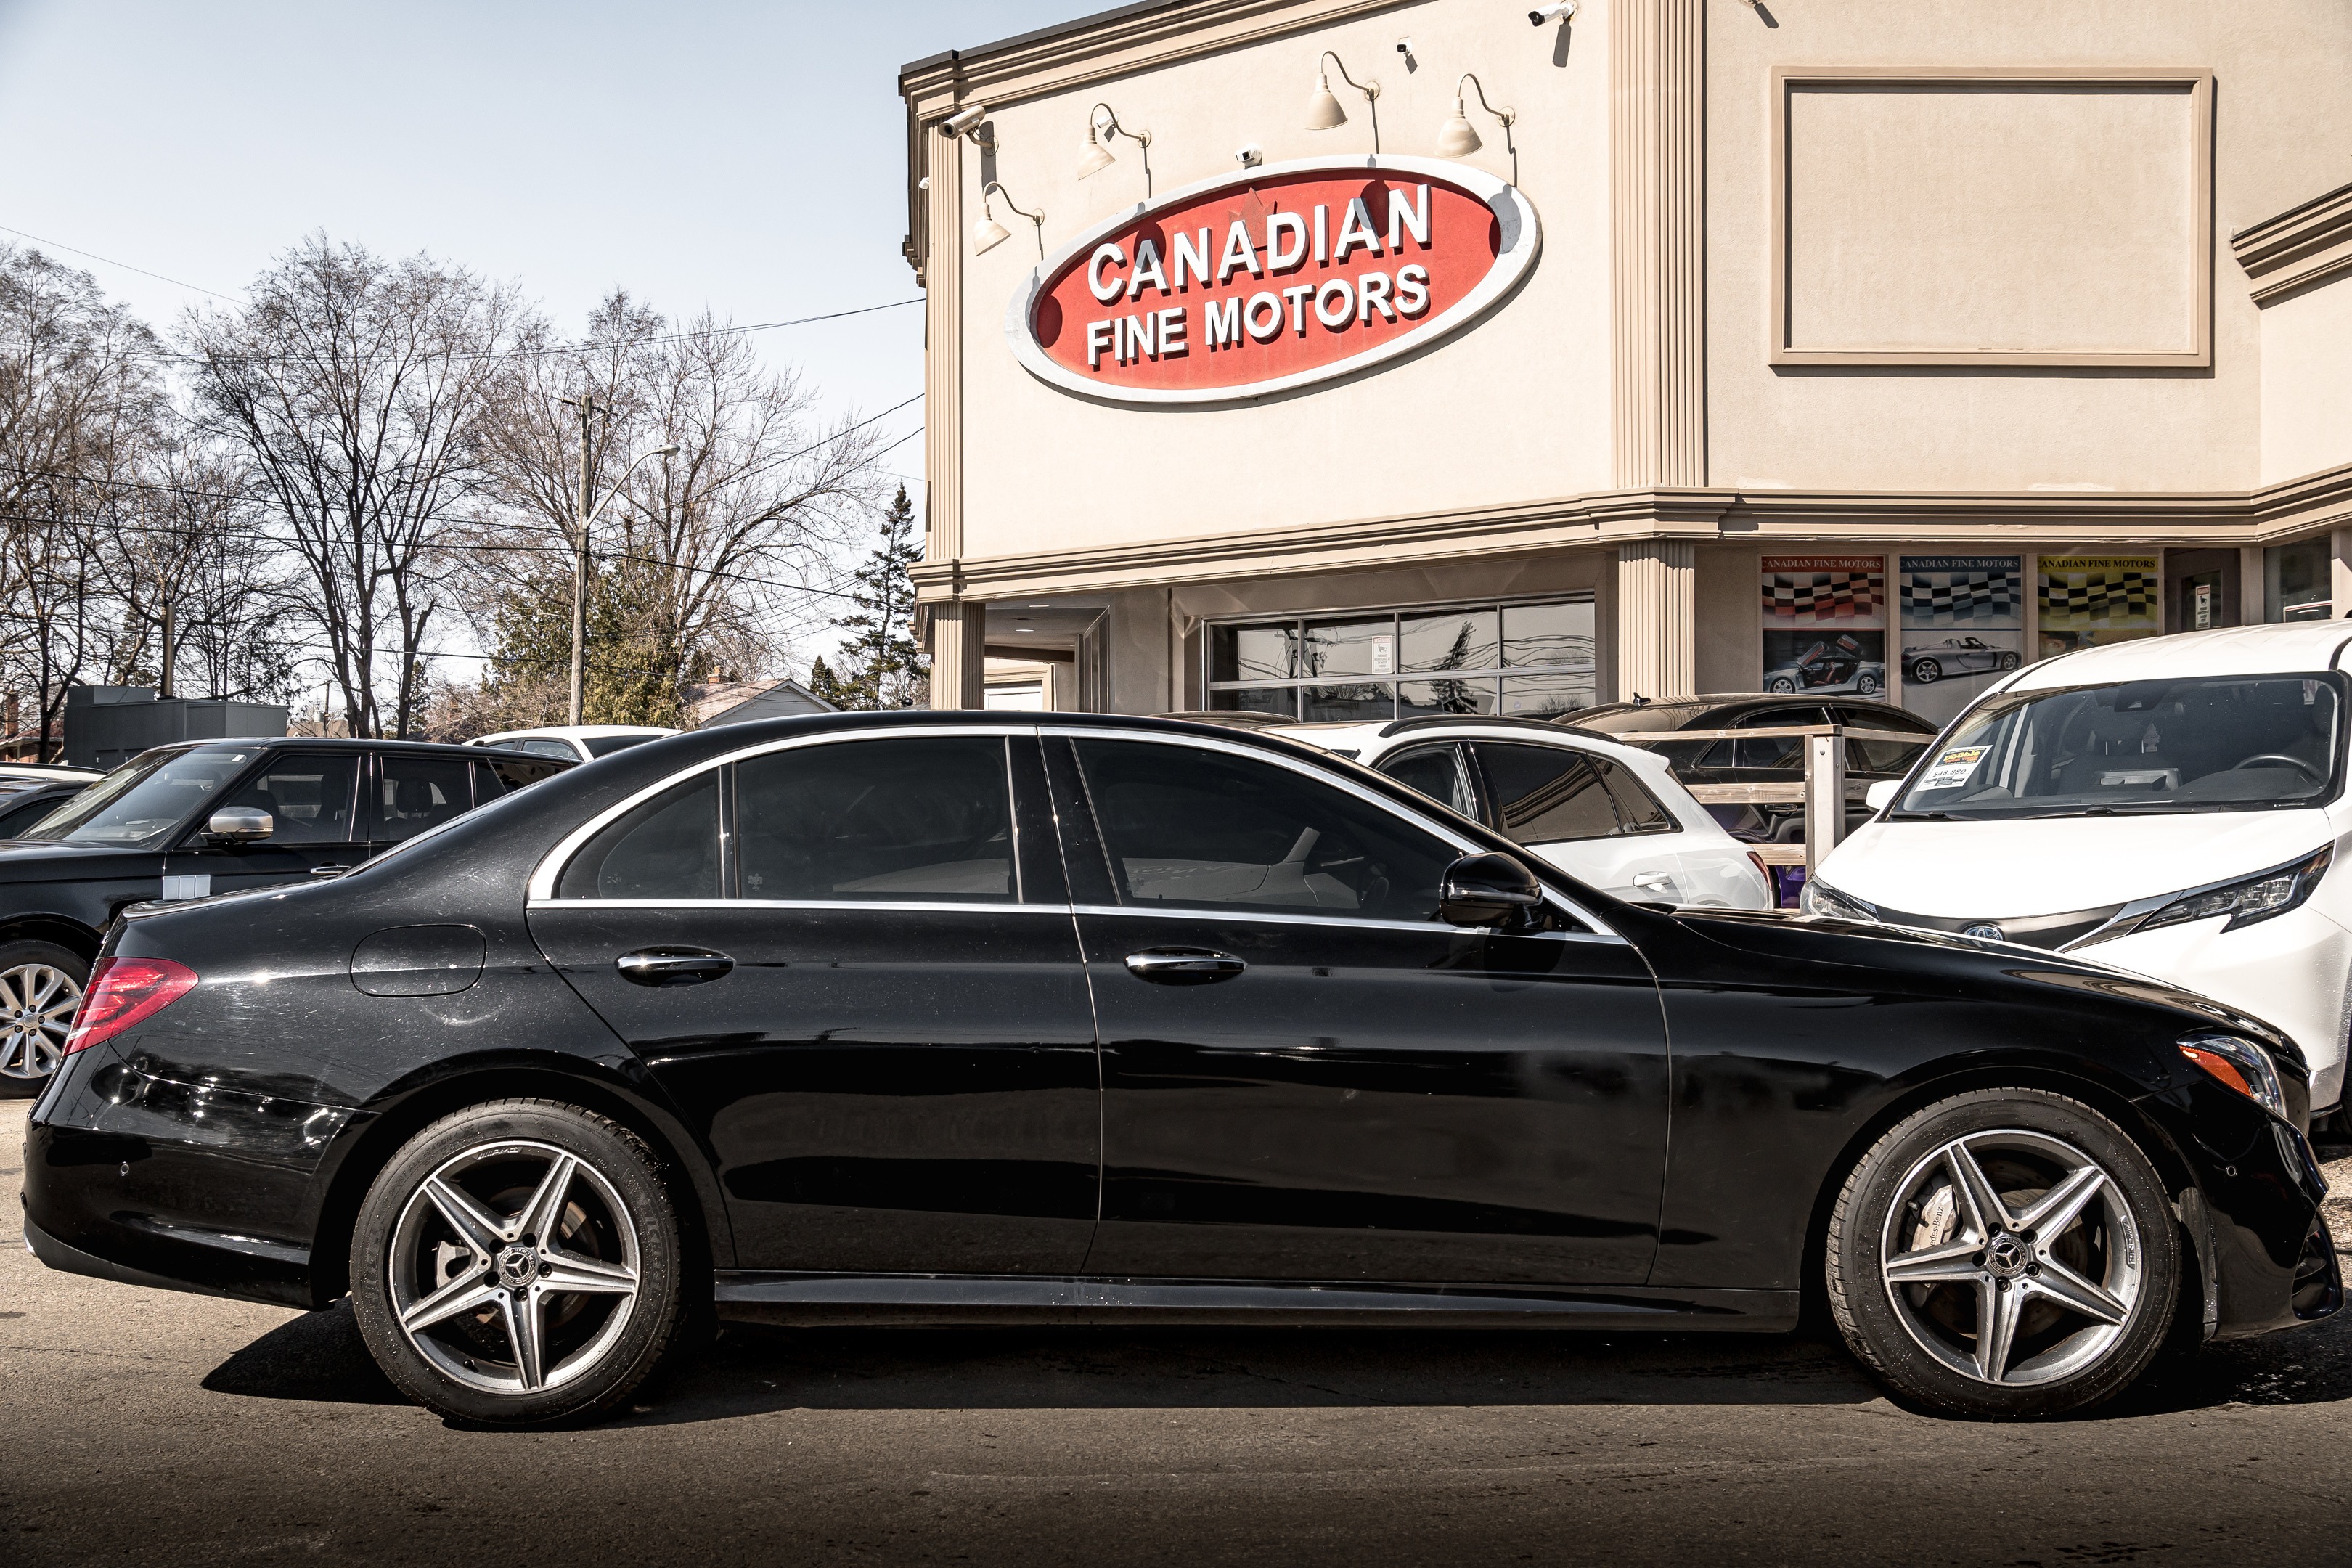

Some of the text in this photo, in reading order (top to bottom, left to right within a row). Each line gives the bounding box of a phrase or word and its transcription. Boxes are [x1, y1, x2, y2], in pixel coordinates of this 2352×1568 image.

[1087, 184, 1432, 301] CANADIAN
[1087, 264, 1430, 367] FINE MOTORS
[1839, 560, 1881, 568] MOTORS
[1977, 560, 2019, 568] MOTORS
[2113, 560, 2155, 568] MOTORS
